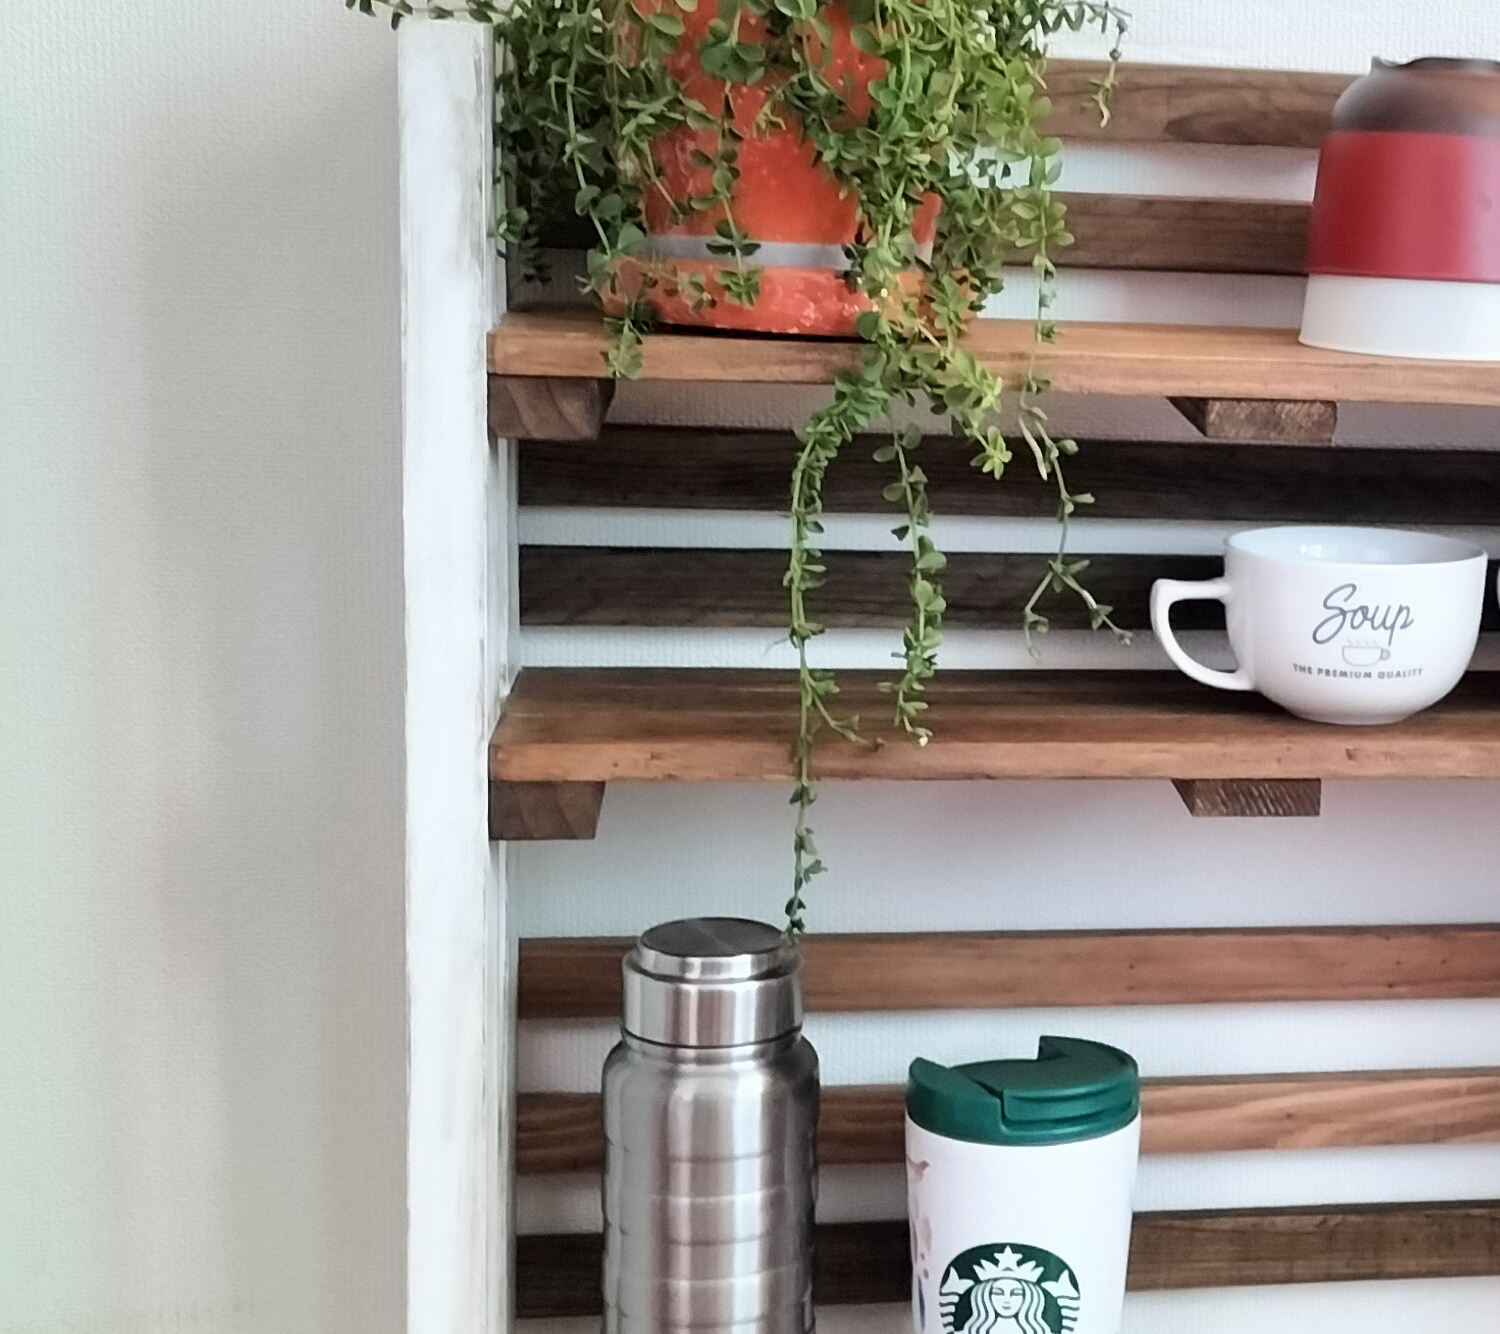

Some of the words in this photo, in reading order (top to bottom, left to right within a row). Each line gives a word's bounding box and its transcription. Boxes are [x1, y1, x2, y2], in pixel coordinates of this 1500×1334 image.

[1312, 582, 1415, 647] Soup
[1293, 663, 1313, 675] THE
[1317, 667, 1372, 679] PREMIUM
[1377, 667, 1424, 680] QUALITY
